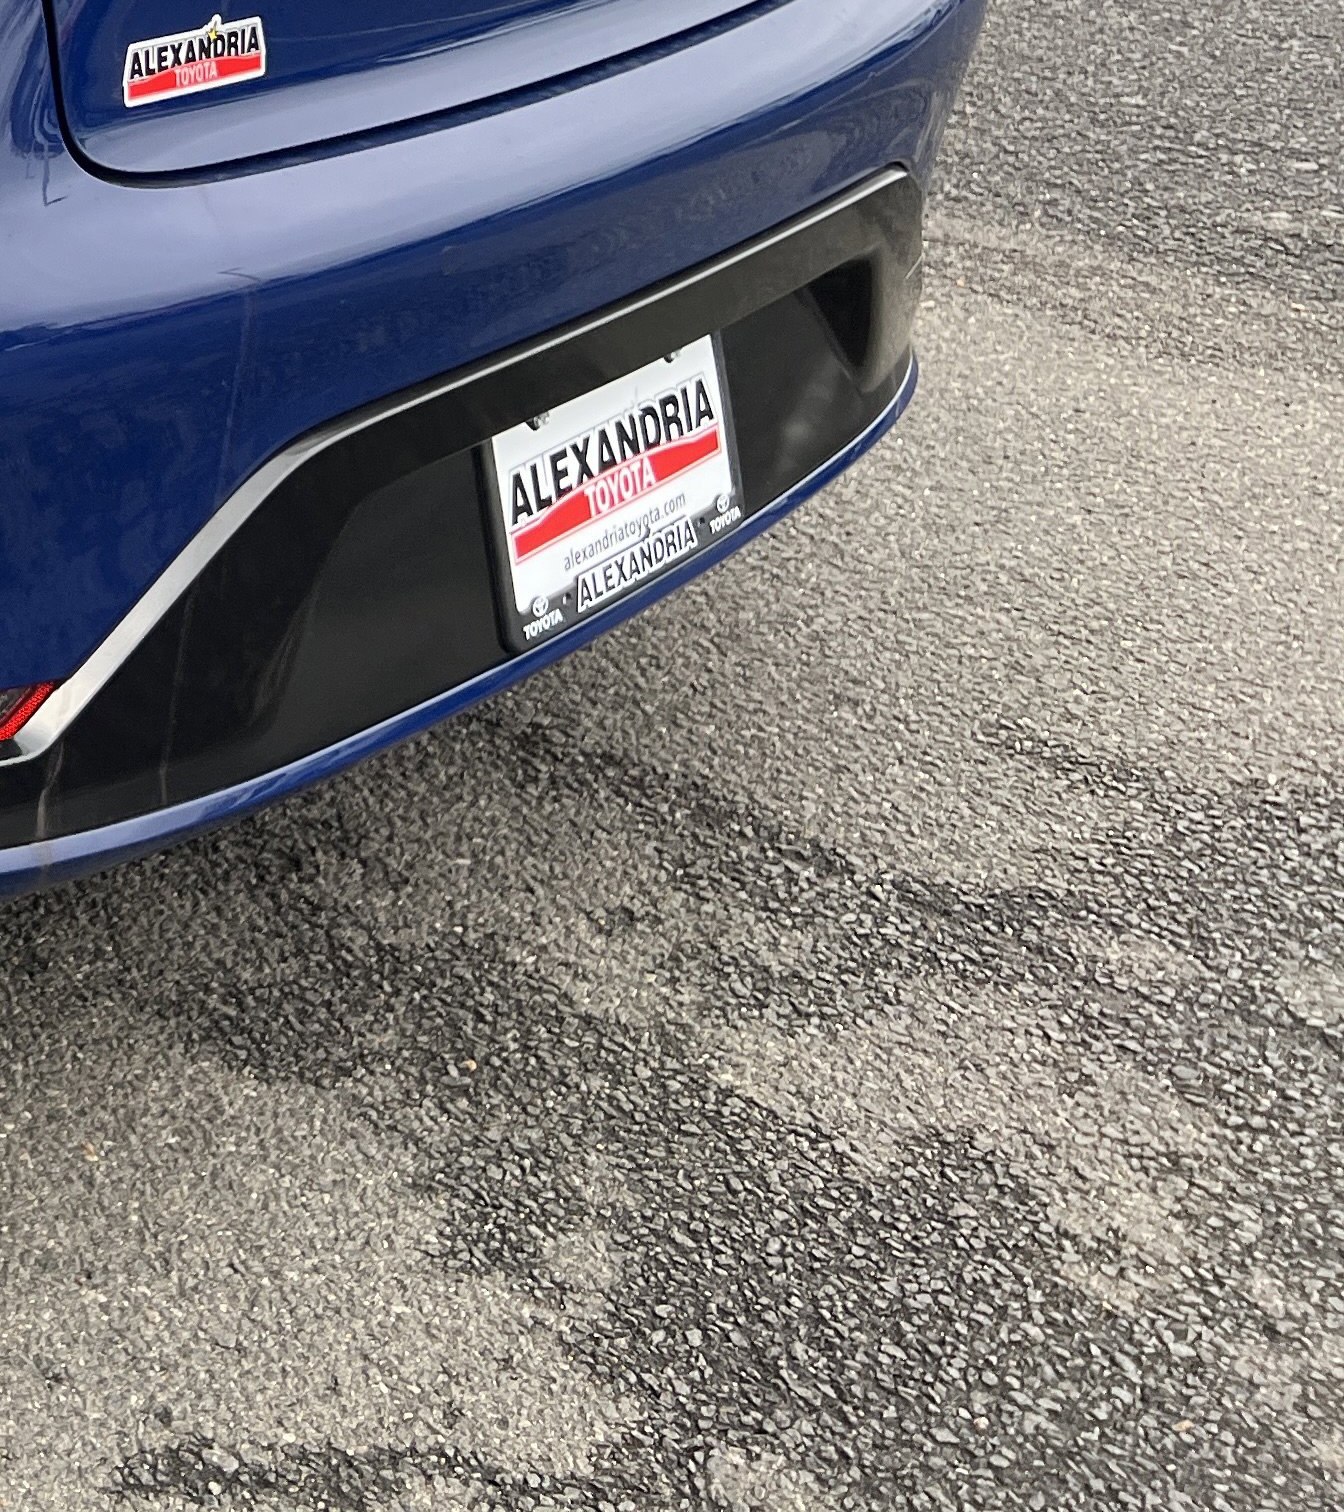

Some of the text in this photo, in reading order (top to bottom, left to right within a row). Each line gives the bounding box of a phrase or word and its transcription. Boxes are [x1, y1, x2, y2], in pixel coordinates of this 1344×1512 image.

[130, 26, 260, 80] ALEXANDRIA
[174, 60, 219, 88] TOYOTA
[511, 377, 715, 527] ALEXANDRIA
[583, 458, 657, 519] TOYOTA
[563, 491, 687, 571] alexandriatoyota.com
[708, 505, 742, 535] TOYOTA
[578, 519, 696, 609] ALEXANDRIA
[523, 610, 564, 640] TOYOTA
